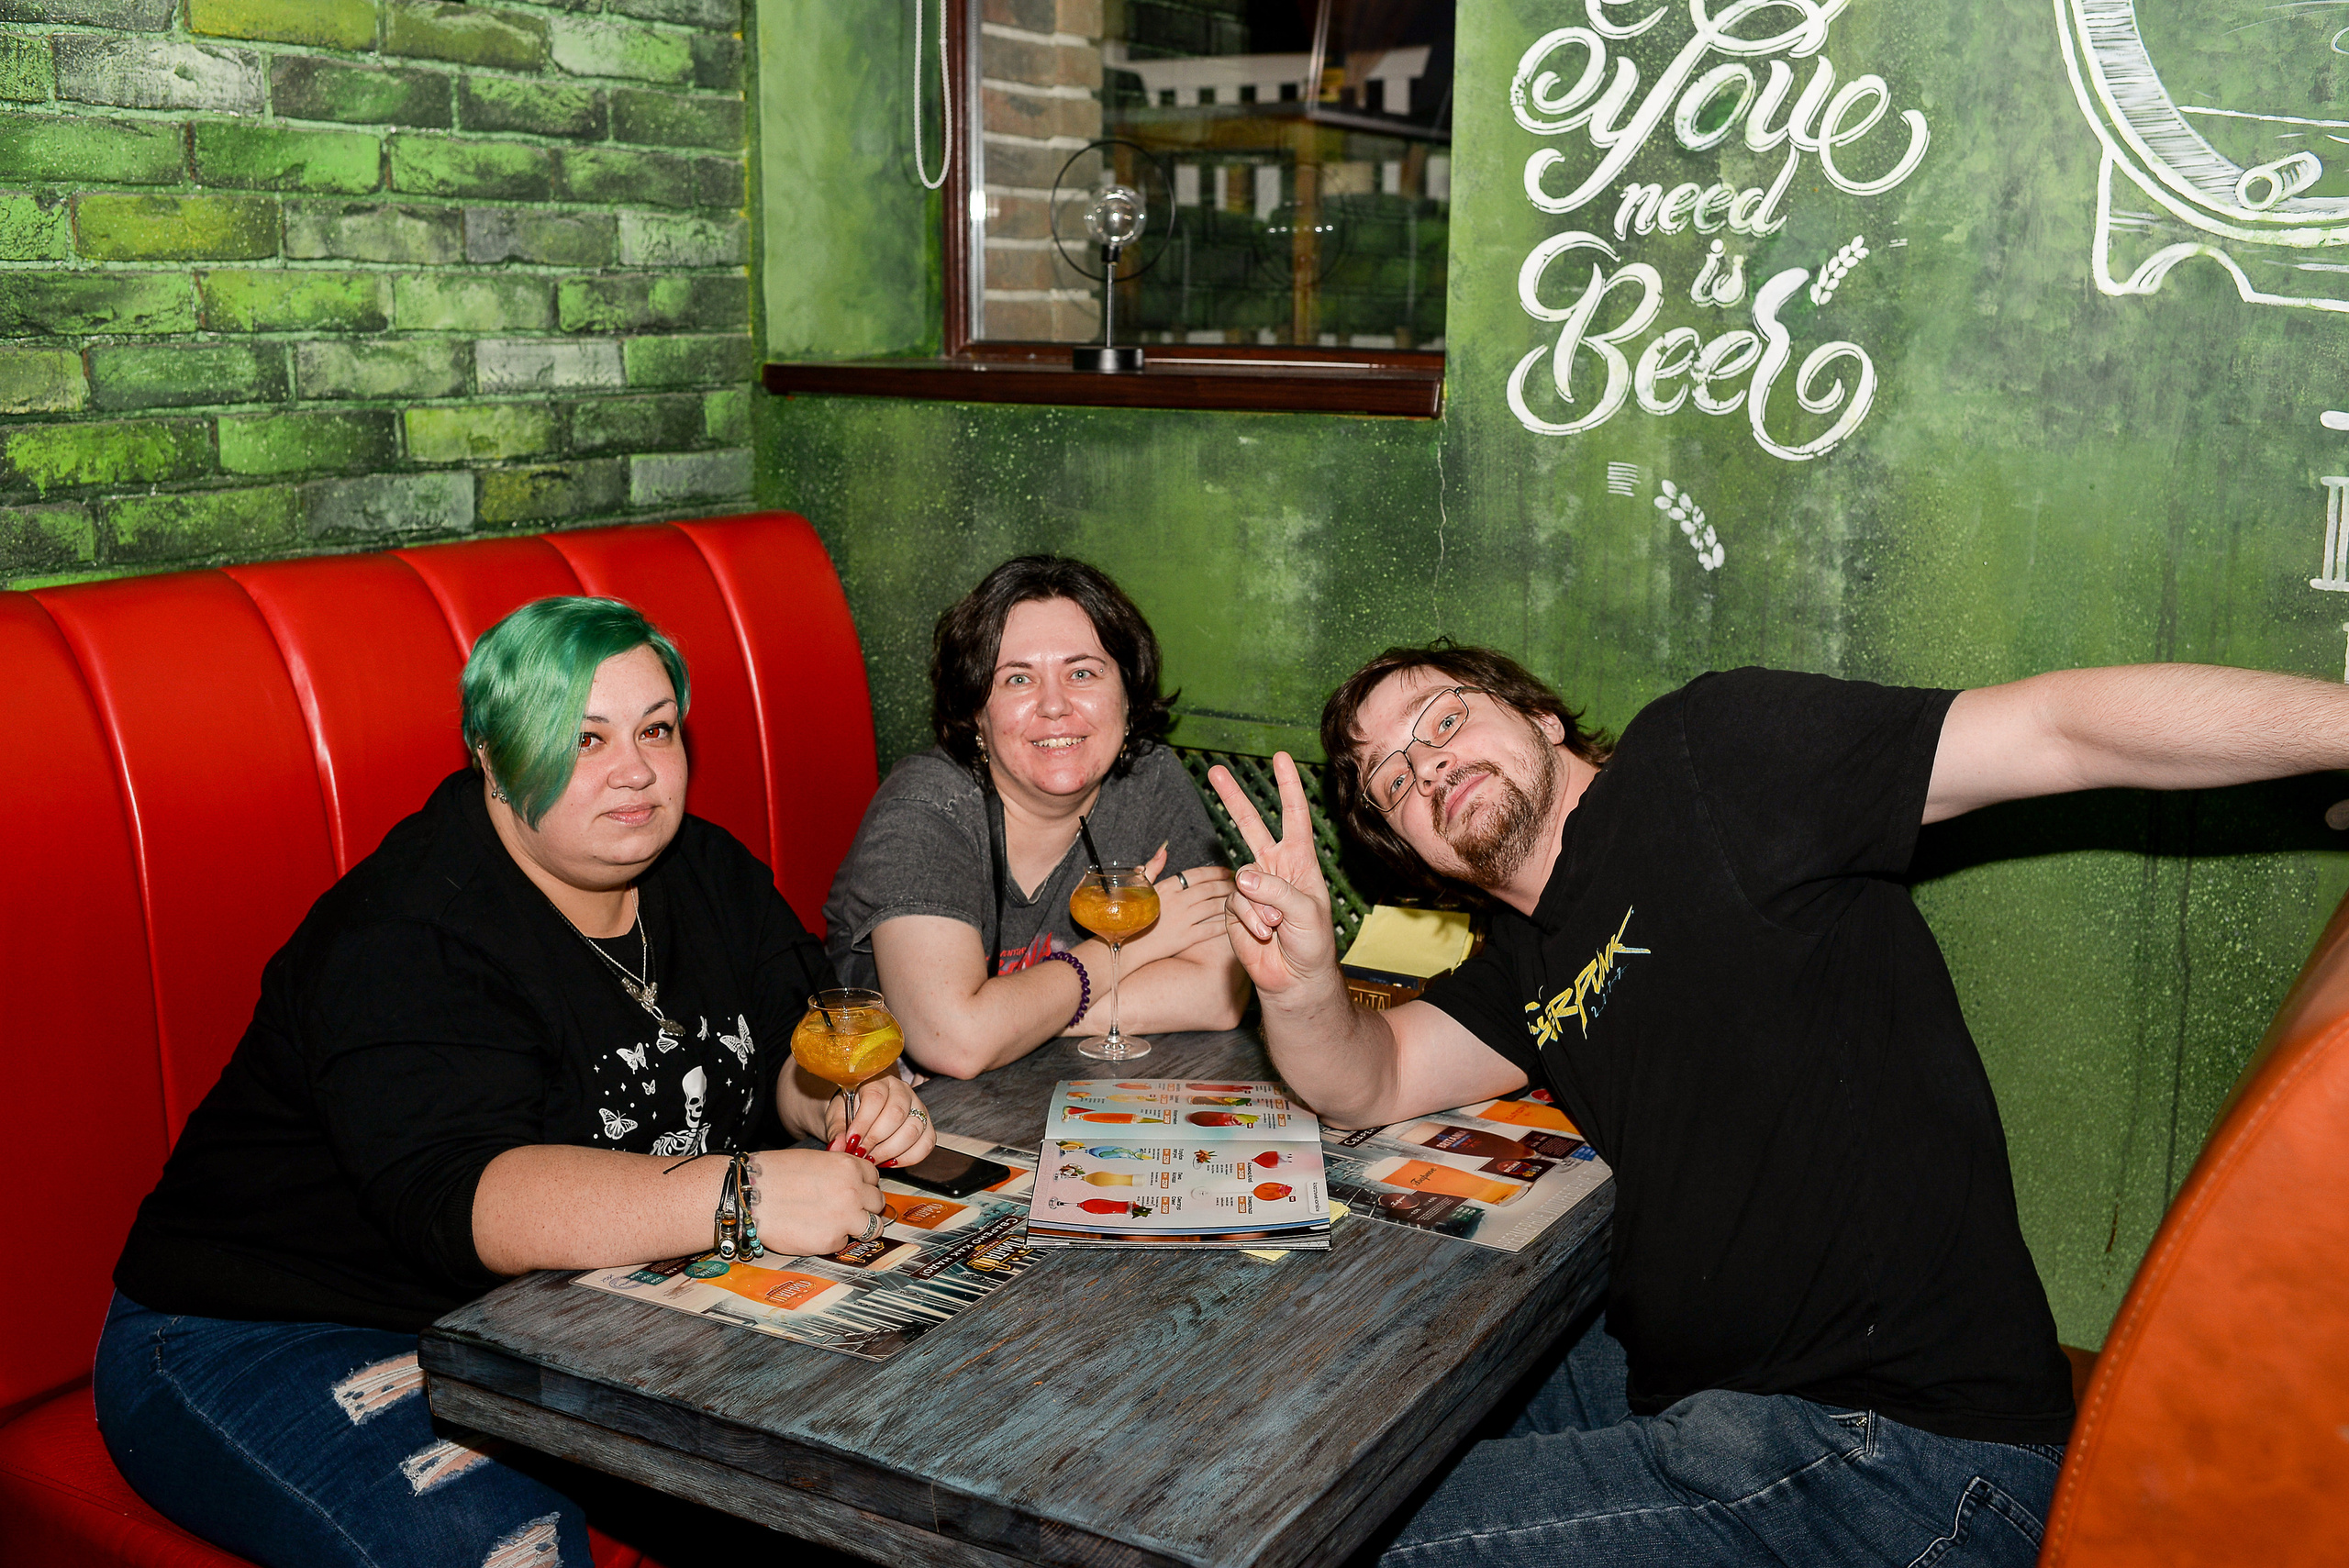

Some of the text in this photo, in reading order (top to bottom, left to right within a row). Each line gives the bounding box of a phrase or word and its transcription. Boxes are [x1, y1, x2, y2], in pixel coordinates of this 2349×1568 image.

[1613, 145, 1800, 240] need
[1690, 239, 1747, 307] is
[1506, 230, 1877, 461] Beer
[1344, 1128, 1381, 1146] СВАРЕ
[971, 1218, 1019, 1244] СВАРЕНО
[950, 1243, 974, 1257] КАК
[918, 1257, 953, 1278] НАДО!
